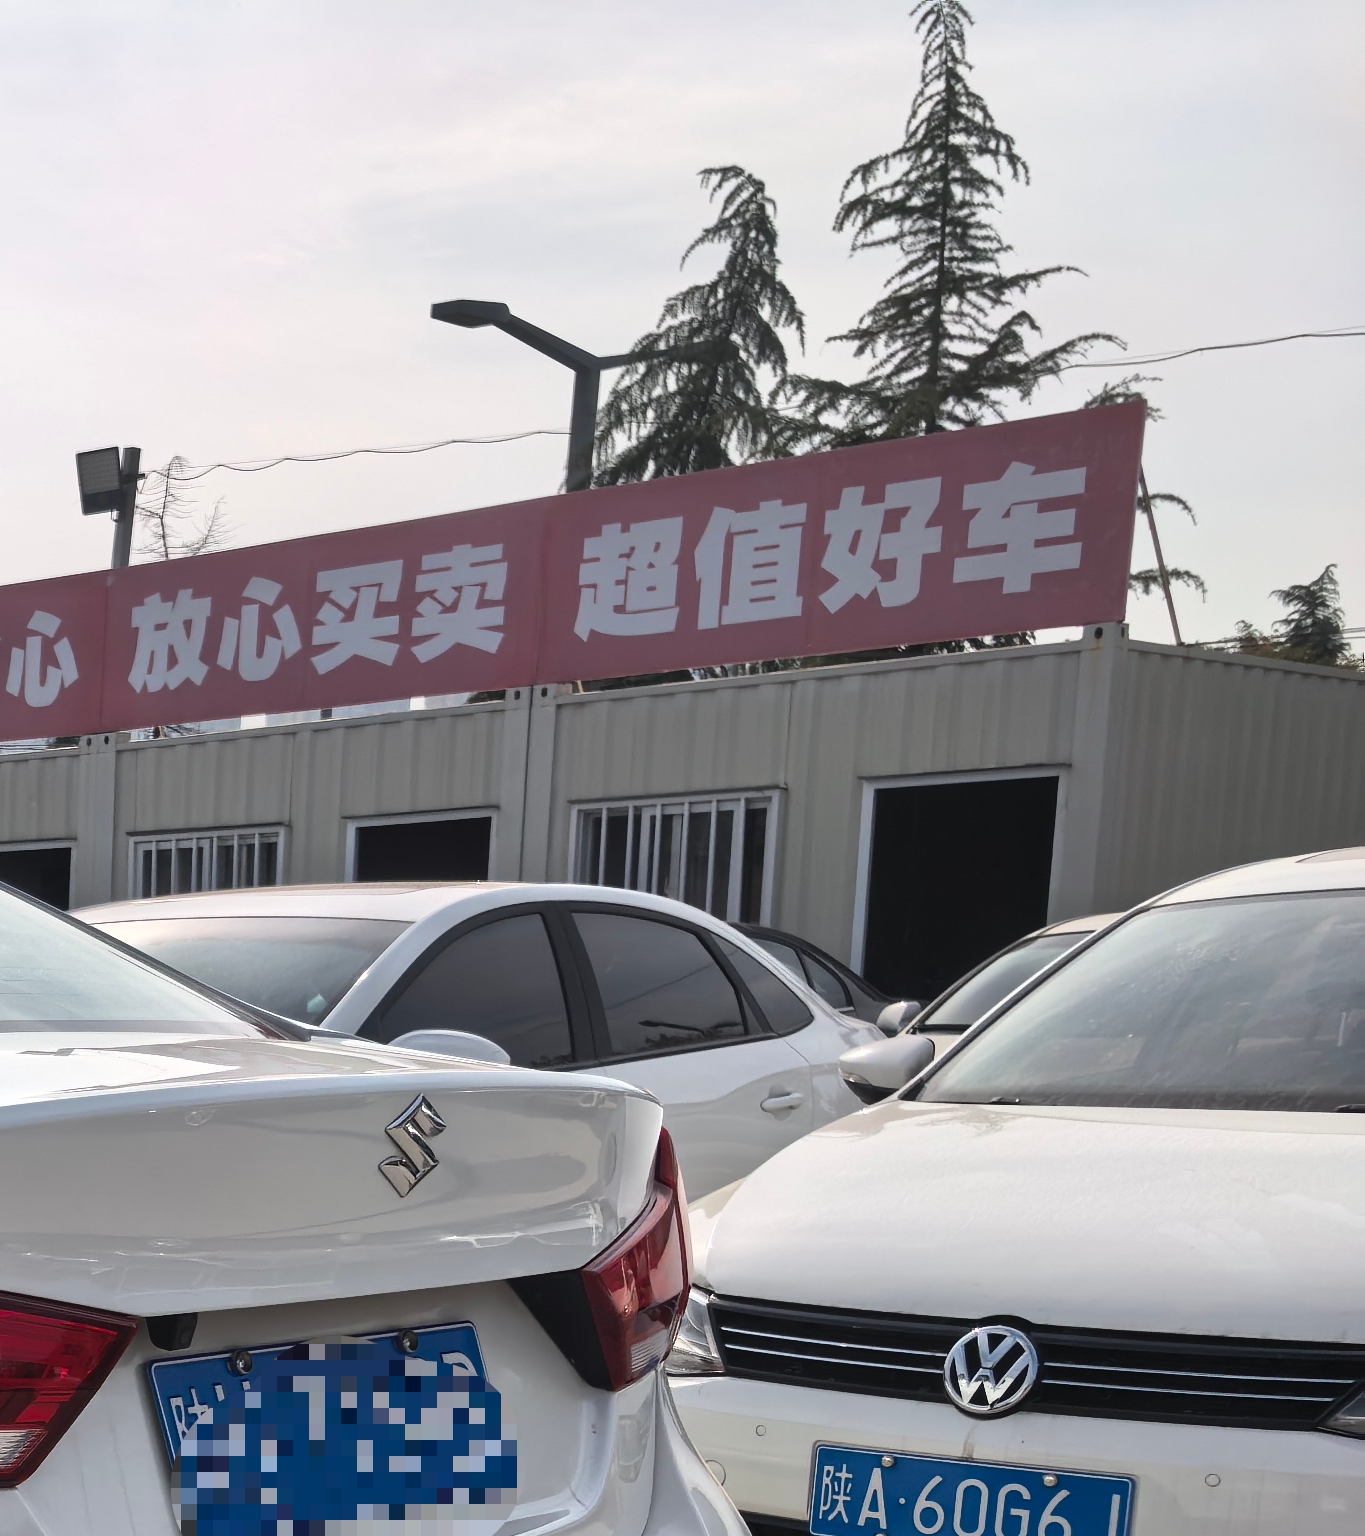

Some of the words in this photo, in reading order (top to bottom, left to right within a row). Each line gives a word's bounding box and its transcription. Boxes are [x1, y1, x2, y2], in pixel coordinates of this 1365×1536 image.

[127, 542, 510, 693] 放心买卖
[573, 462, 1087, 642] 超值好车
